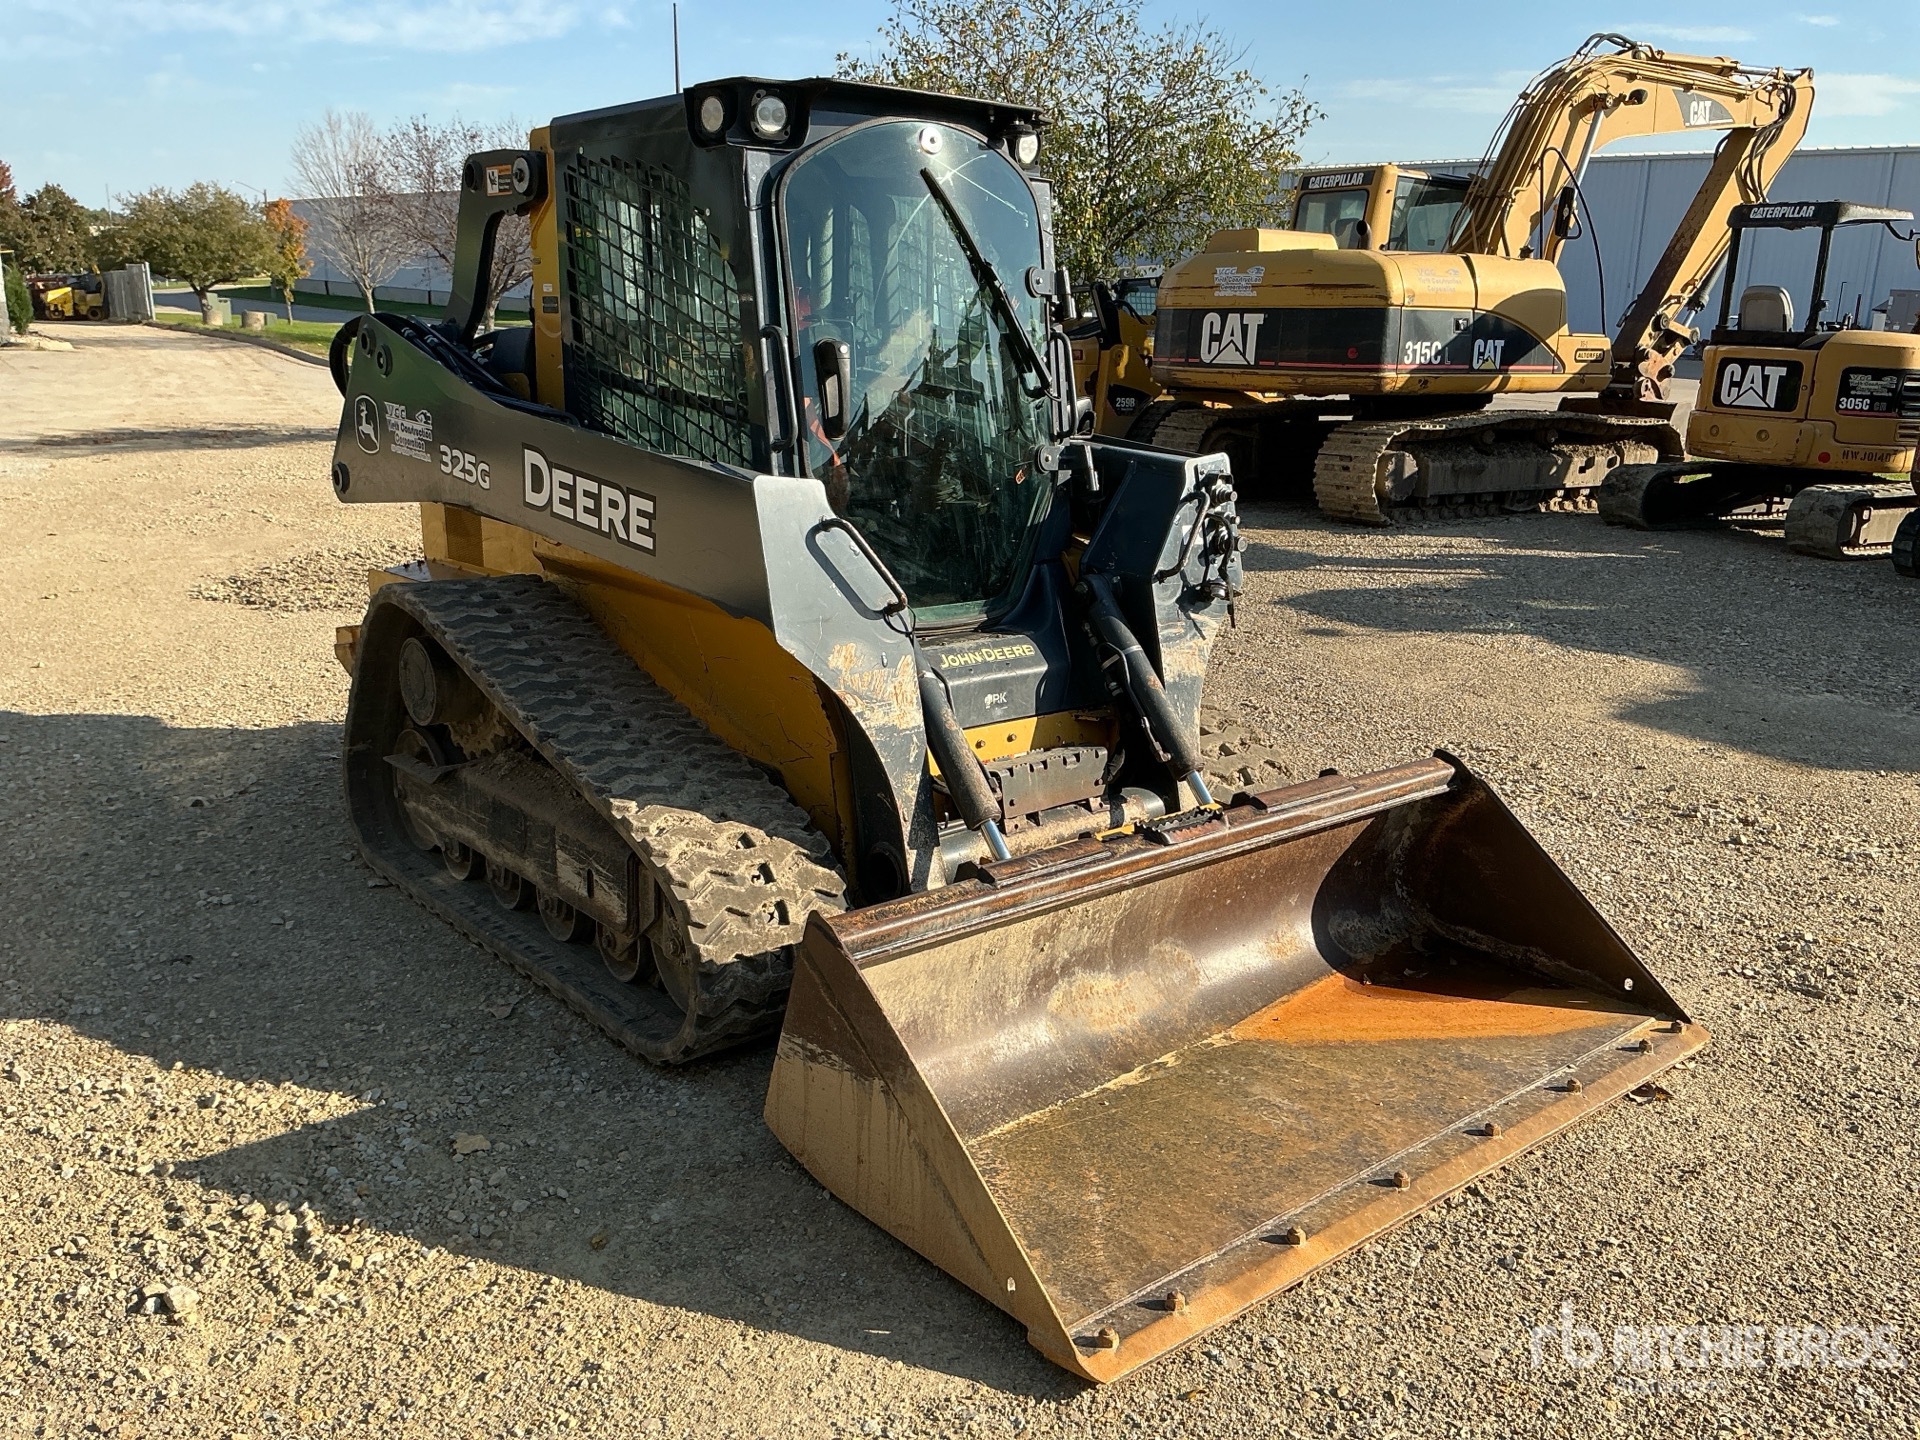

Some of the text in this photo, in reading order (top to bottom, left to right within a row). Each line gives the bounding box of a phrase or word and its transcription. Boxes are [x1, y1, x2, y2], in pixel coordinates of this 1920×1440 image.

[1690, 100, 1712, 126] CAT
[1309, 173, 1364, 188] CATERPILLAR
[1749, 205, 1815, 218] CATERPILLAR
[1200, 312, 1265, 365] CAT
[1404, 340, 1442, 365] 315C
[1473, 338, 1505, 370] CAT
[1720, 363, 1787, 408] CAT
[1839, 397, 1870, 411] 305C
[439, 444, 490, 490] 325G
[523, 447, 655, 551] DEERE
[941, 645, 1034, 668] JOHN DEERE
